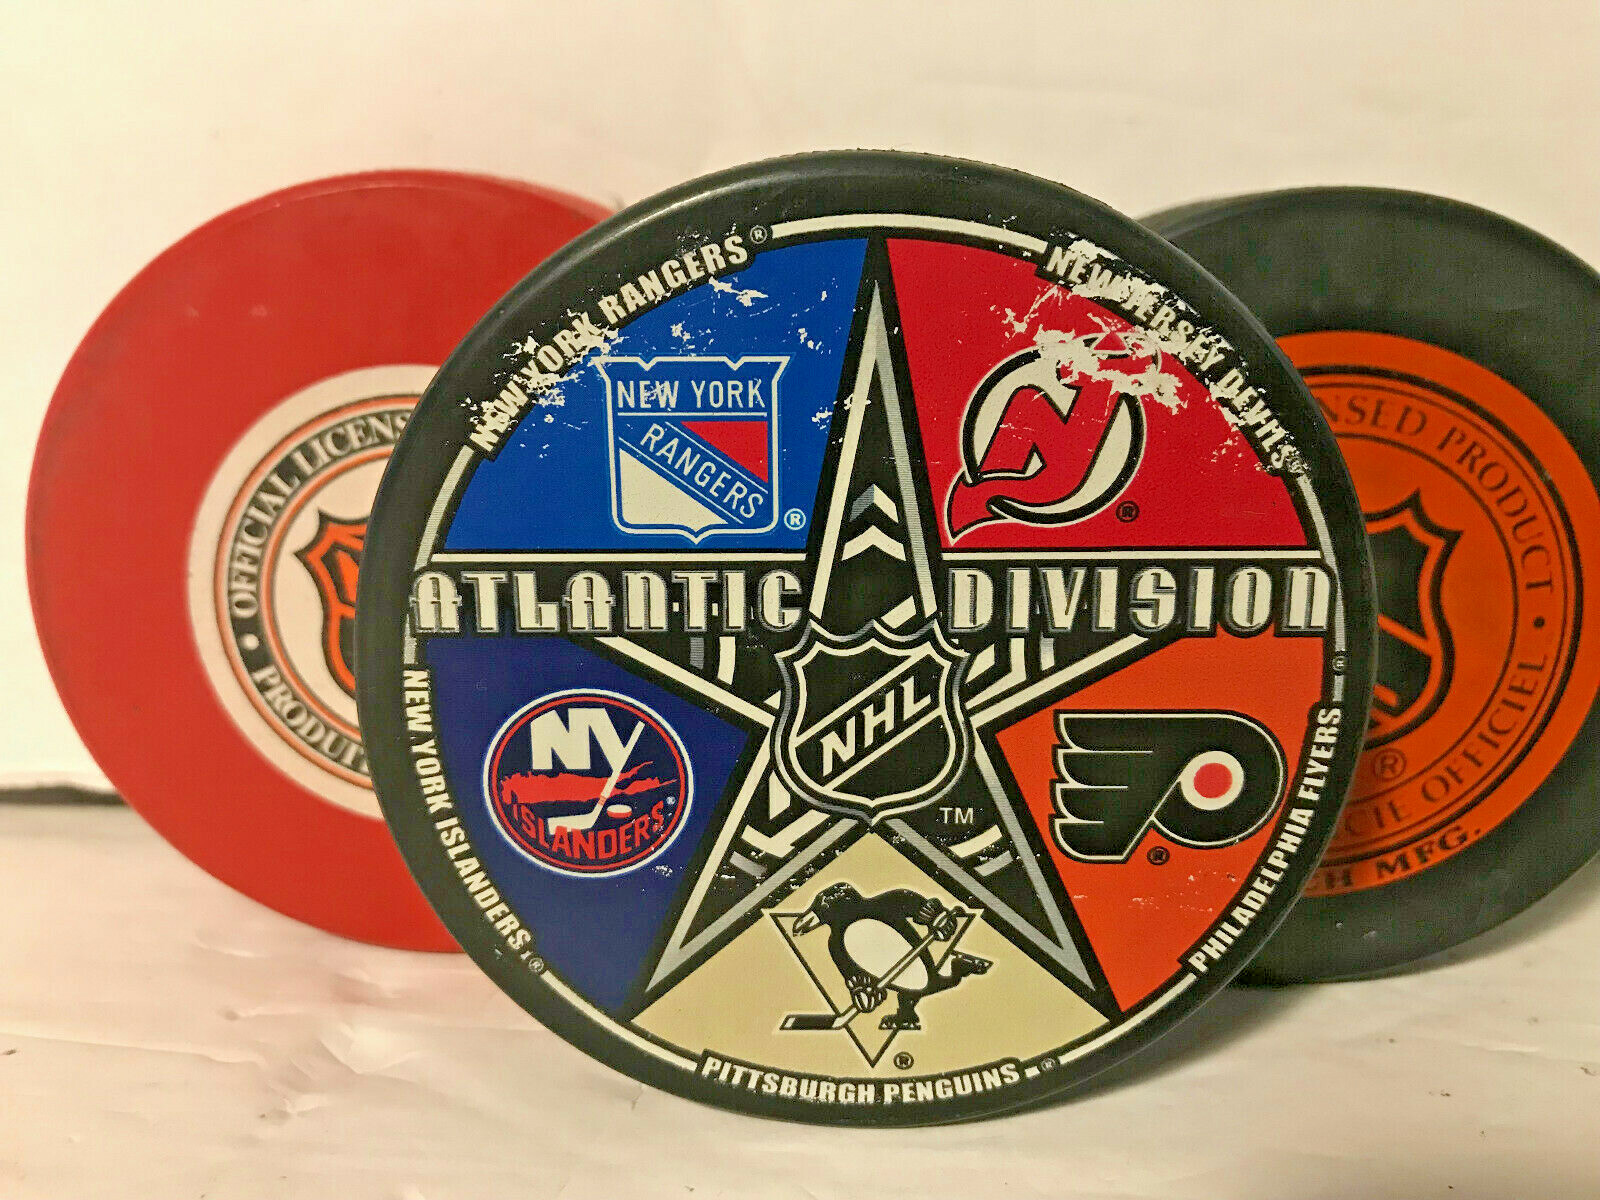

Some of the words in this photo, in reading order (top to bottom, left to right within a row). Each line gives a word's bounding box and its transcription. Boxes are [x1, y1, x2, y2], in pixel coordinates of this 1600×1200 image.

[470, 381, 529, 452] NEW
[520, 312, 604, 386] YORK
[597, 234, 748, 325] RANGERS
[617, 379, 679, 409] NEW
[691, 379, 766, 409] YORK
[639, 422, 765, 520] RANGERS
[1436, 425, 1554, 593] PRODUCT
[231, 472, 301, 619] OFFICIAL
[409, 569, 803, 634] ATLANTIC
[947, 566, 1332, 633] DIVISION
[402, 669, 433, 733] NEW
[820, 671, 932, 776] NHL
[1420, 652, 1549, 802] OFFICIEL
[411, 738, 453, 815] YORK
[530, 707, 646, 773] NY
[512, 800, 665, 861] ISLANDERS
[939, 807, 974, 825] TM
[1187, 805, 1314, 974] PHILADELPHIA
[1297, 707, 1342, 802] FLYERS
[1376, 825, 1482, 879] MFG.
[434, 817, 532, 951] ISLANDERS
[701, 1056, 875, 1105] PITTSBURGH
[882, 1063, 1020, 1105] PENGUINS
